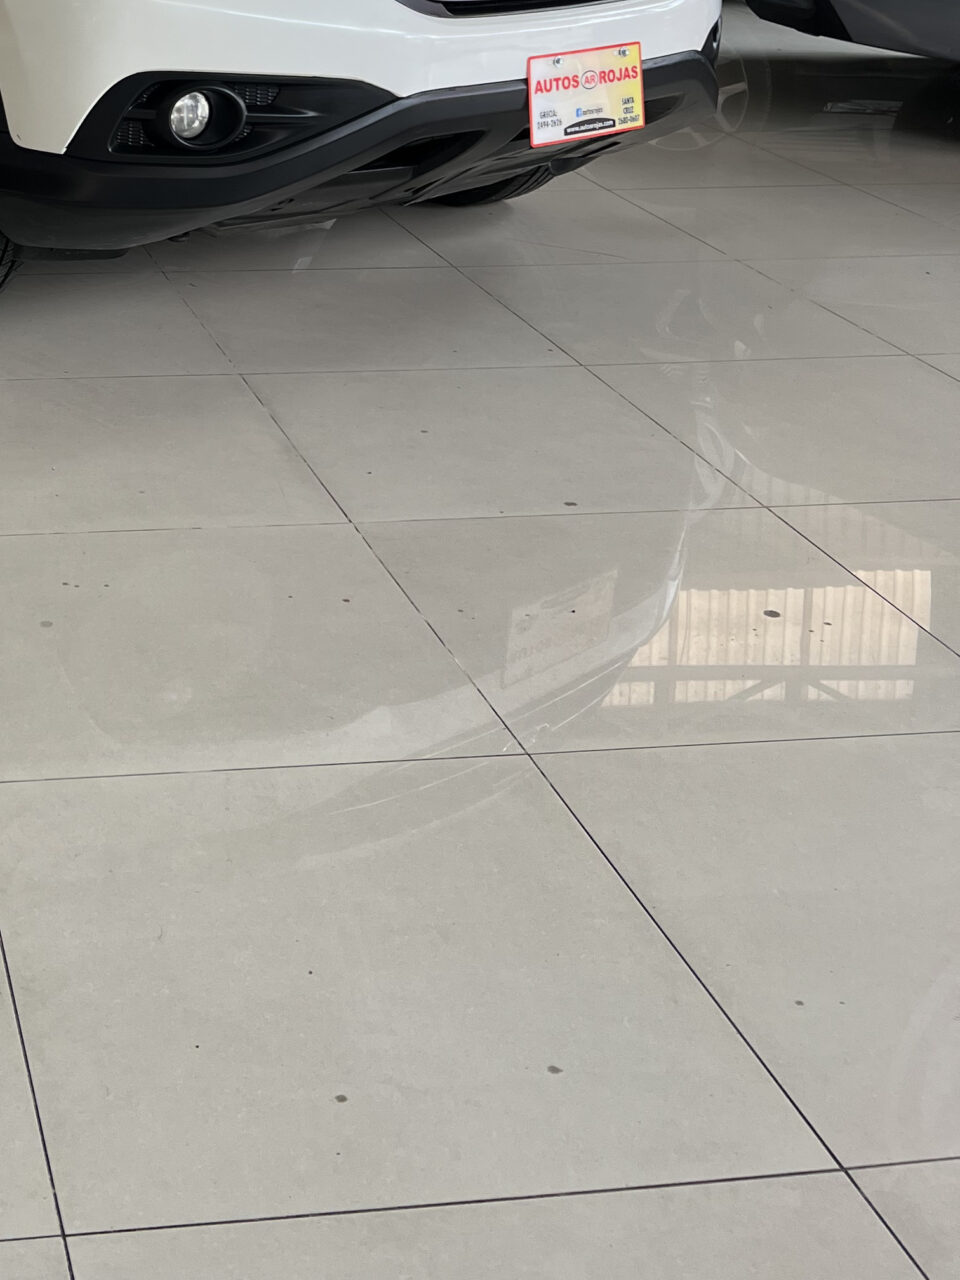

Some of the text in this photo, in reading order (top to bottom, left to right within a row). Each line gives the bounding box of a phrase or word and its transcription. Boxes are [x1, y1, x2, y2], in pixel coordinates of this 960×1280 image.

[534, 66, 638, 94] AUTOS AR ROJAS
